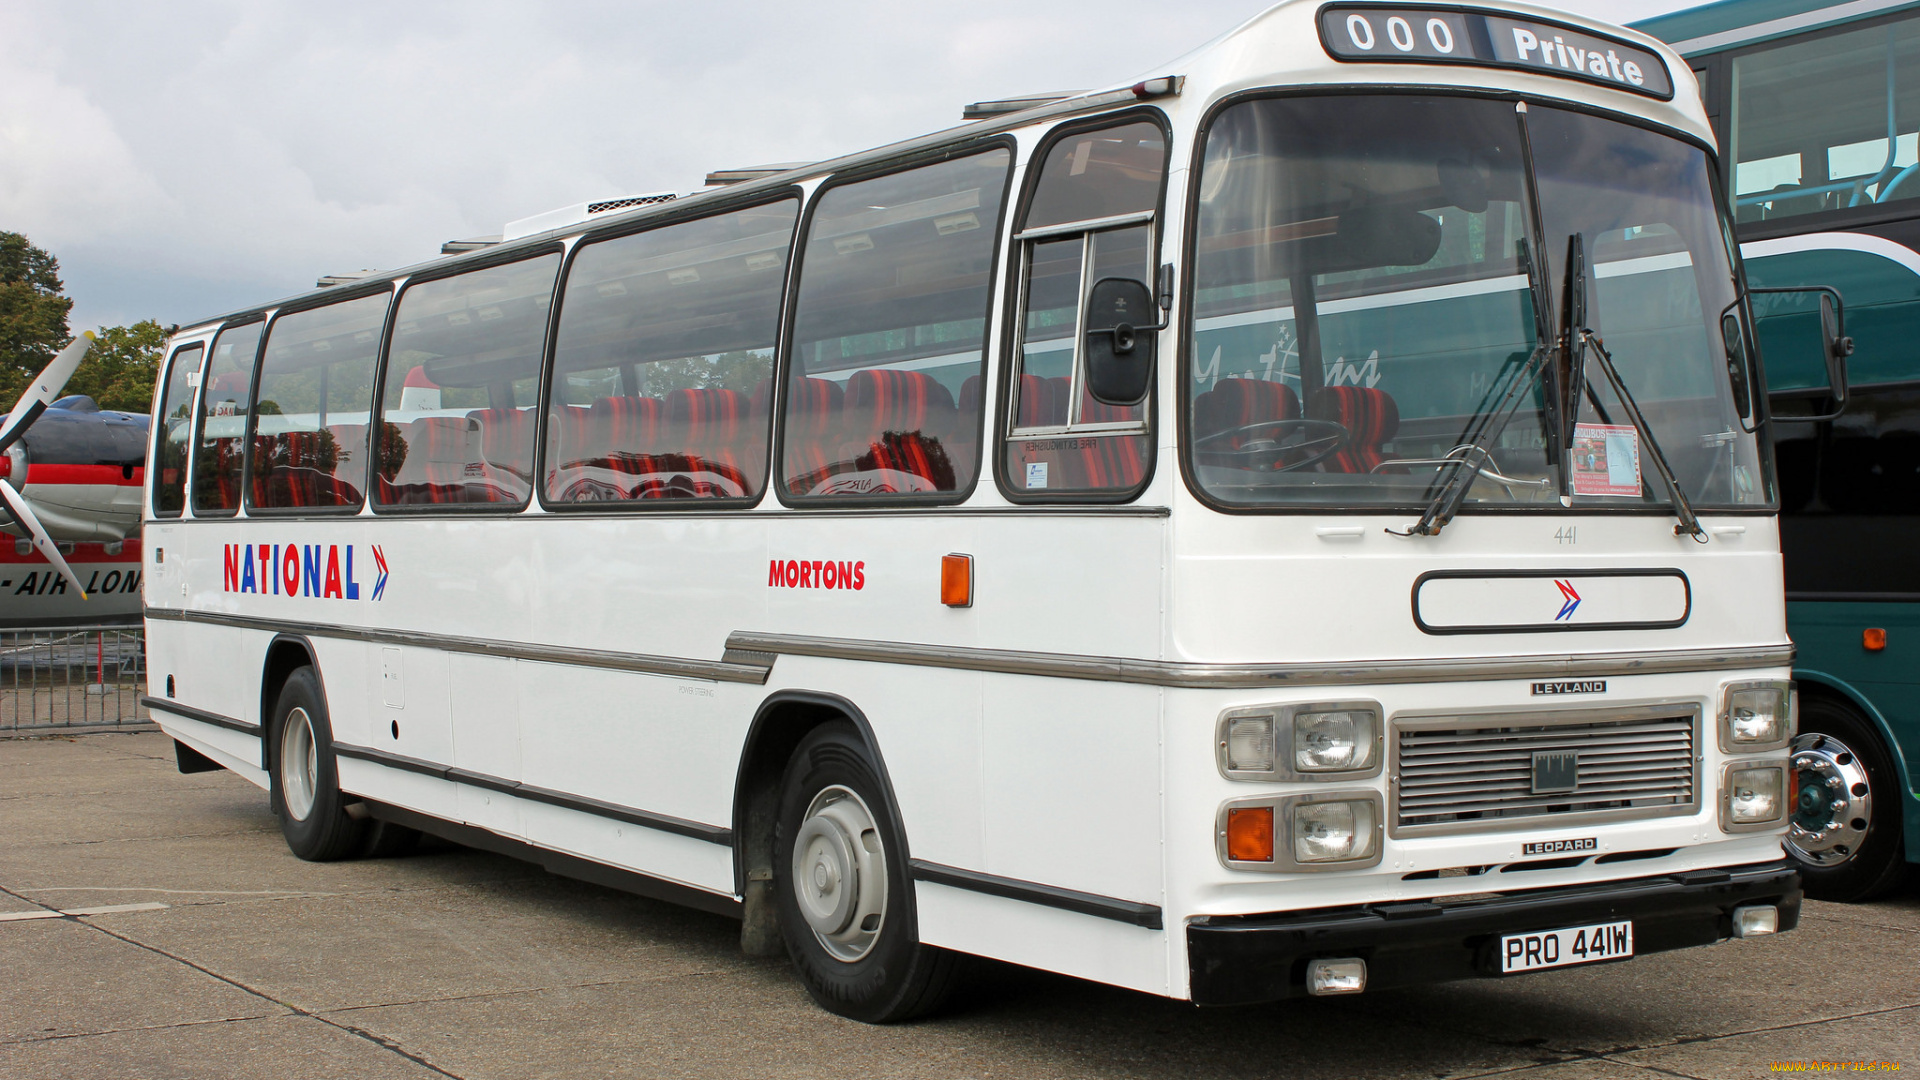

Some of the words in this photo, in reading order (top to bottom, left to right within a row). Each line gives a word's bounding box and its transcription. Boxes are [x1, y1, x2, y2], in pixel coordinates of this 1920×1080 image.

[1512, 27, 1645, 87] Private
[1553, 525, 1578, 545] 441
[224, 543, 360, 600] NATIONAL
[768, 560, 865, 591] MORTONS
[1535, 682, 1604, 695] LEYLAND
[1525, 838, 1595, 854] LEOPARD
[1507, 933, 1559, 969] PRO
[1571, 924, 1628, 959] 441W
